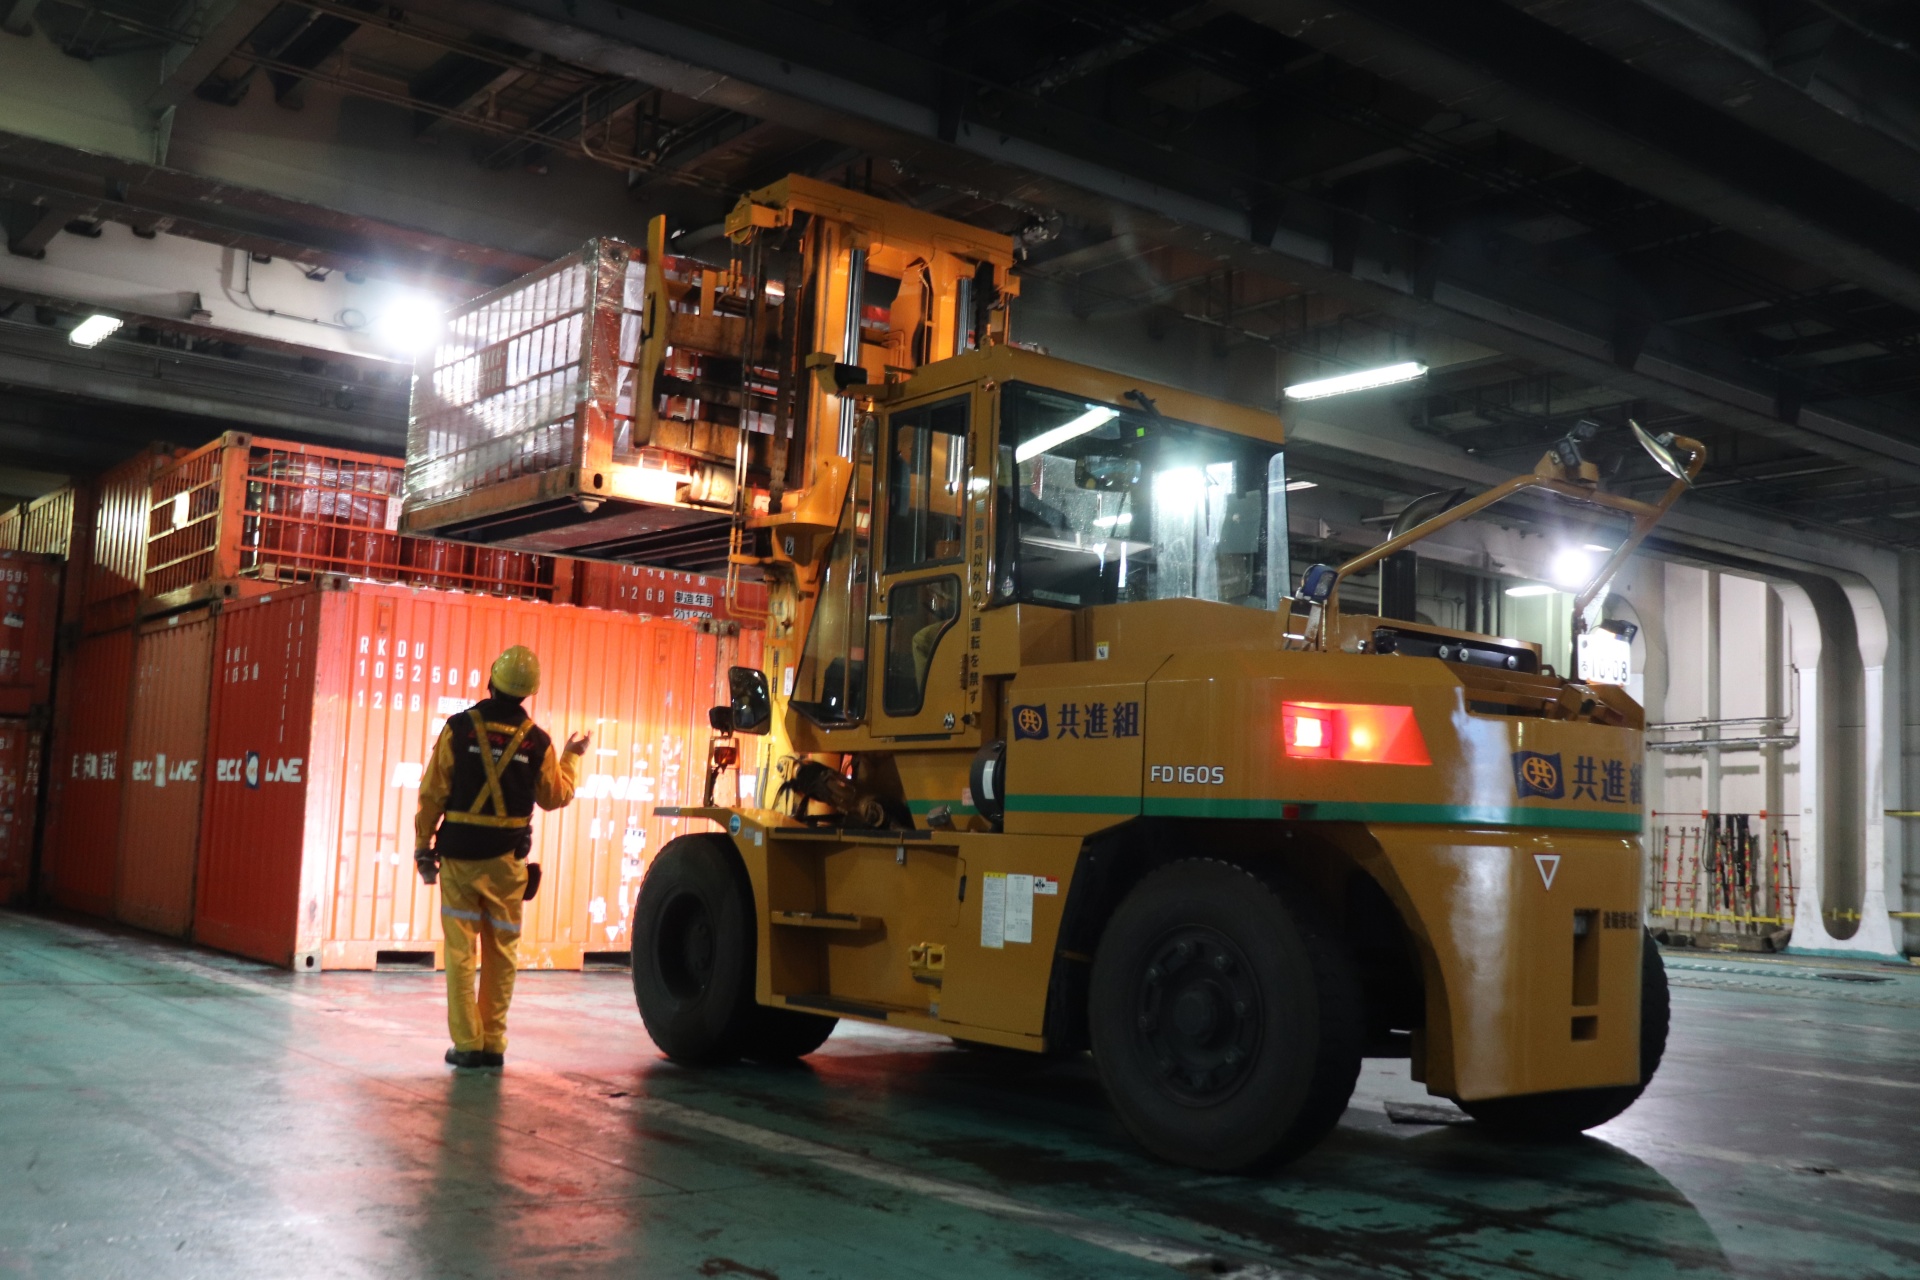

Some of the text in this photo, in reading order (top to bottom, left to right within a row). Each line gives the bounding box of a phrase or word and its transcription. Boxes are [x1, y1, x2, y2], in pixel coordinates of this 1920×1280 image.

[359, 636, 425, 660] RKDU
[359, 659, 480, 688] 1052500
[358, 689, 421, 712] 12GB
[1056, 701, 1140, 740] 共進組
[1151, 765, 1225, 785] FD160S
